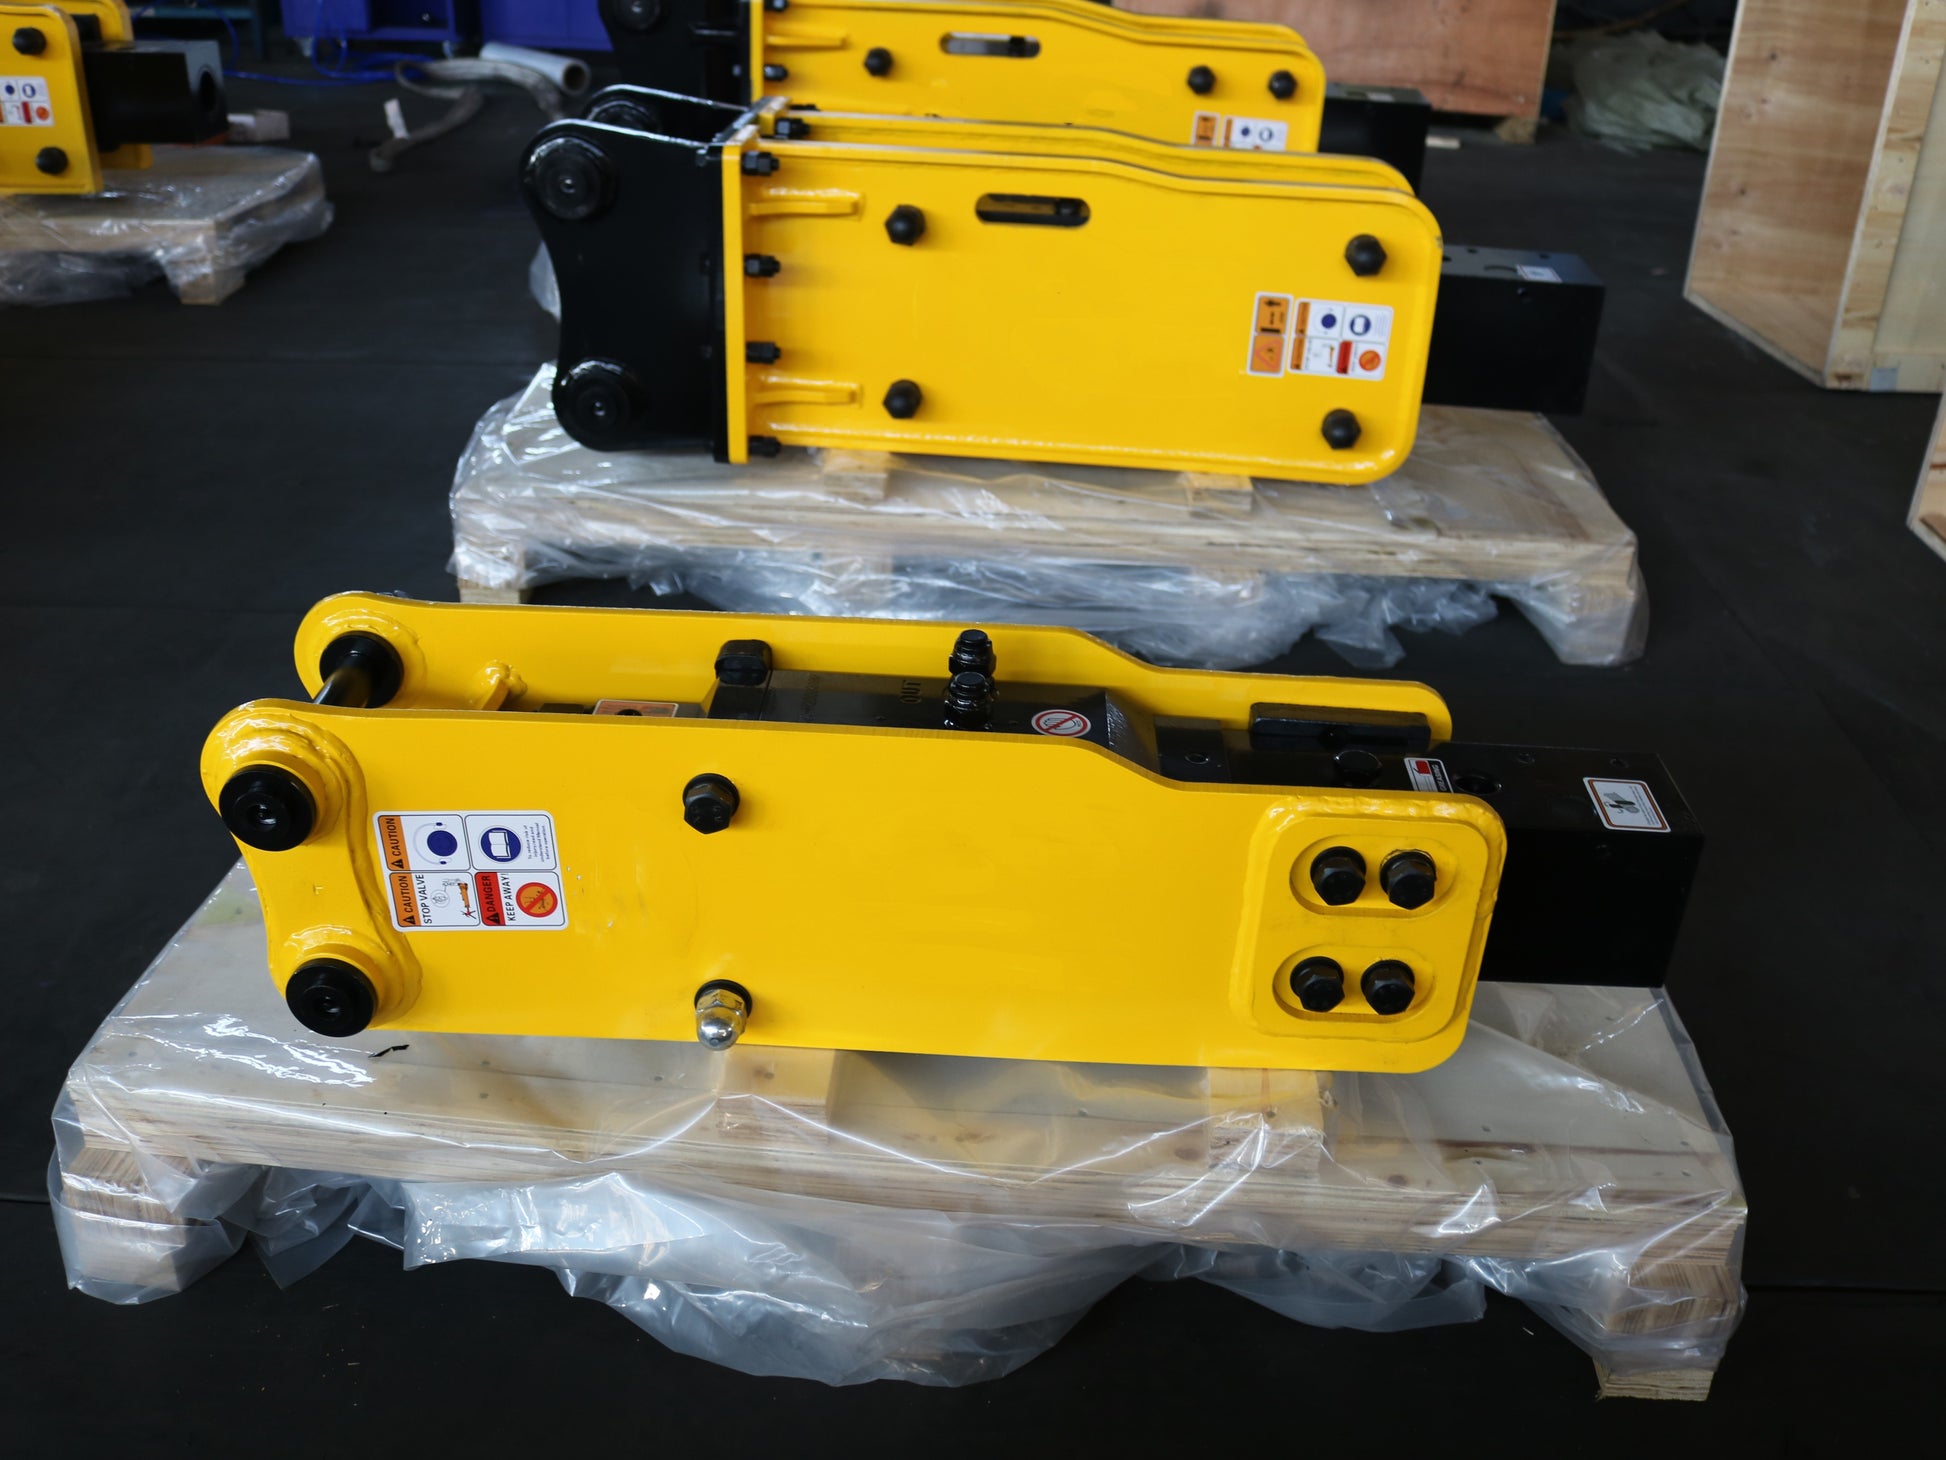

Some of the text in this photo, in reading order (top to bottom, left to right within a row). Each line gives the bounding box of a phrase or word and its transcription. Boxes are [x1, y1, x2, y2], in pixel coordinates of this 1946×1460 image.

[899, 679, 921, 704] OUT
[389, 817, 401, 856] CAUTION
[400, 875, 413, 913] CAUTION
[415, 874, 433, 924] STOP VALVE
[482, 875, 494, 913] DANGER
[501, 873, 516, 922] KEEP AWAY!
